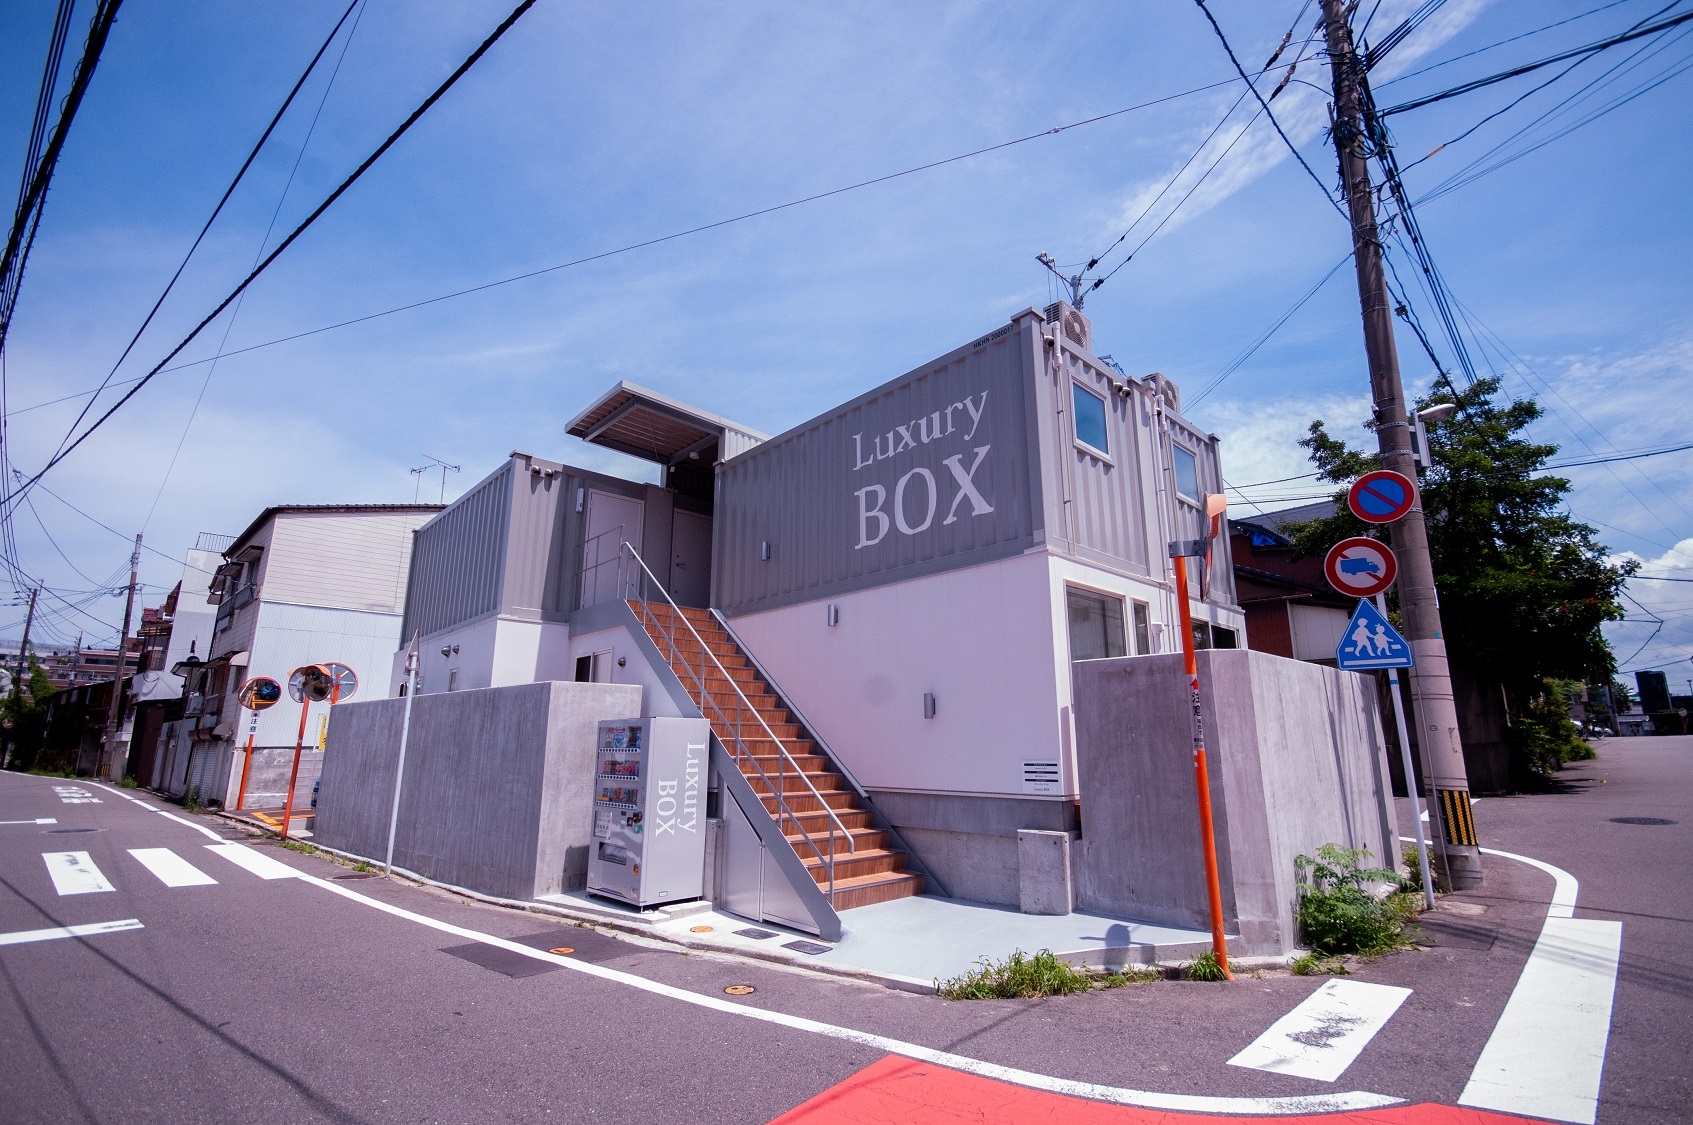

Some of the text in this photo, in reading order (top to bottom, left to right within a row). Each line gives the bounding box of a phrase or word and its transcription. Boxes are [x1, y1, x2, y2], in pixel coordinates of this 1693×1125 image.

[973, 336, 990, 349] HKHN
[852, 390, 989, 471] Luxury
[854, 444, 994, 549] BOX
[249, 718, 258, 733] 注意
[656, 779, 678, 837] BOX
[677, 742, 706, 834] Luxury
